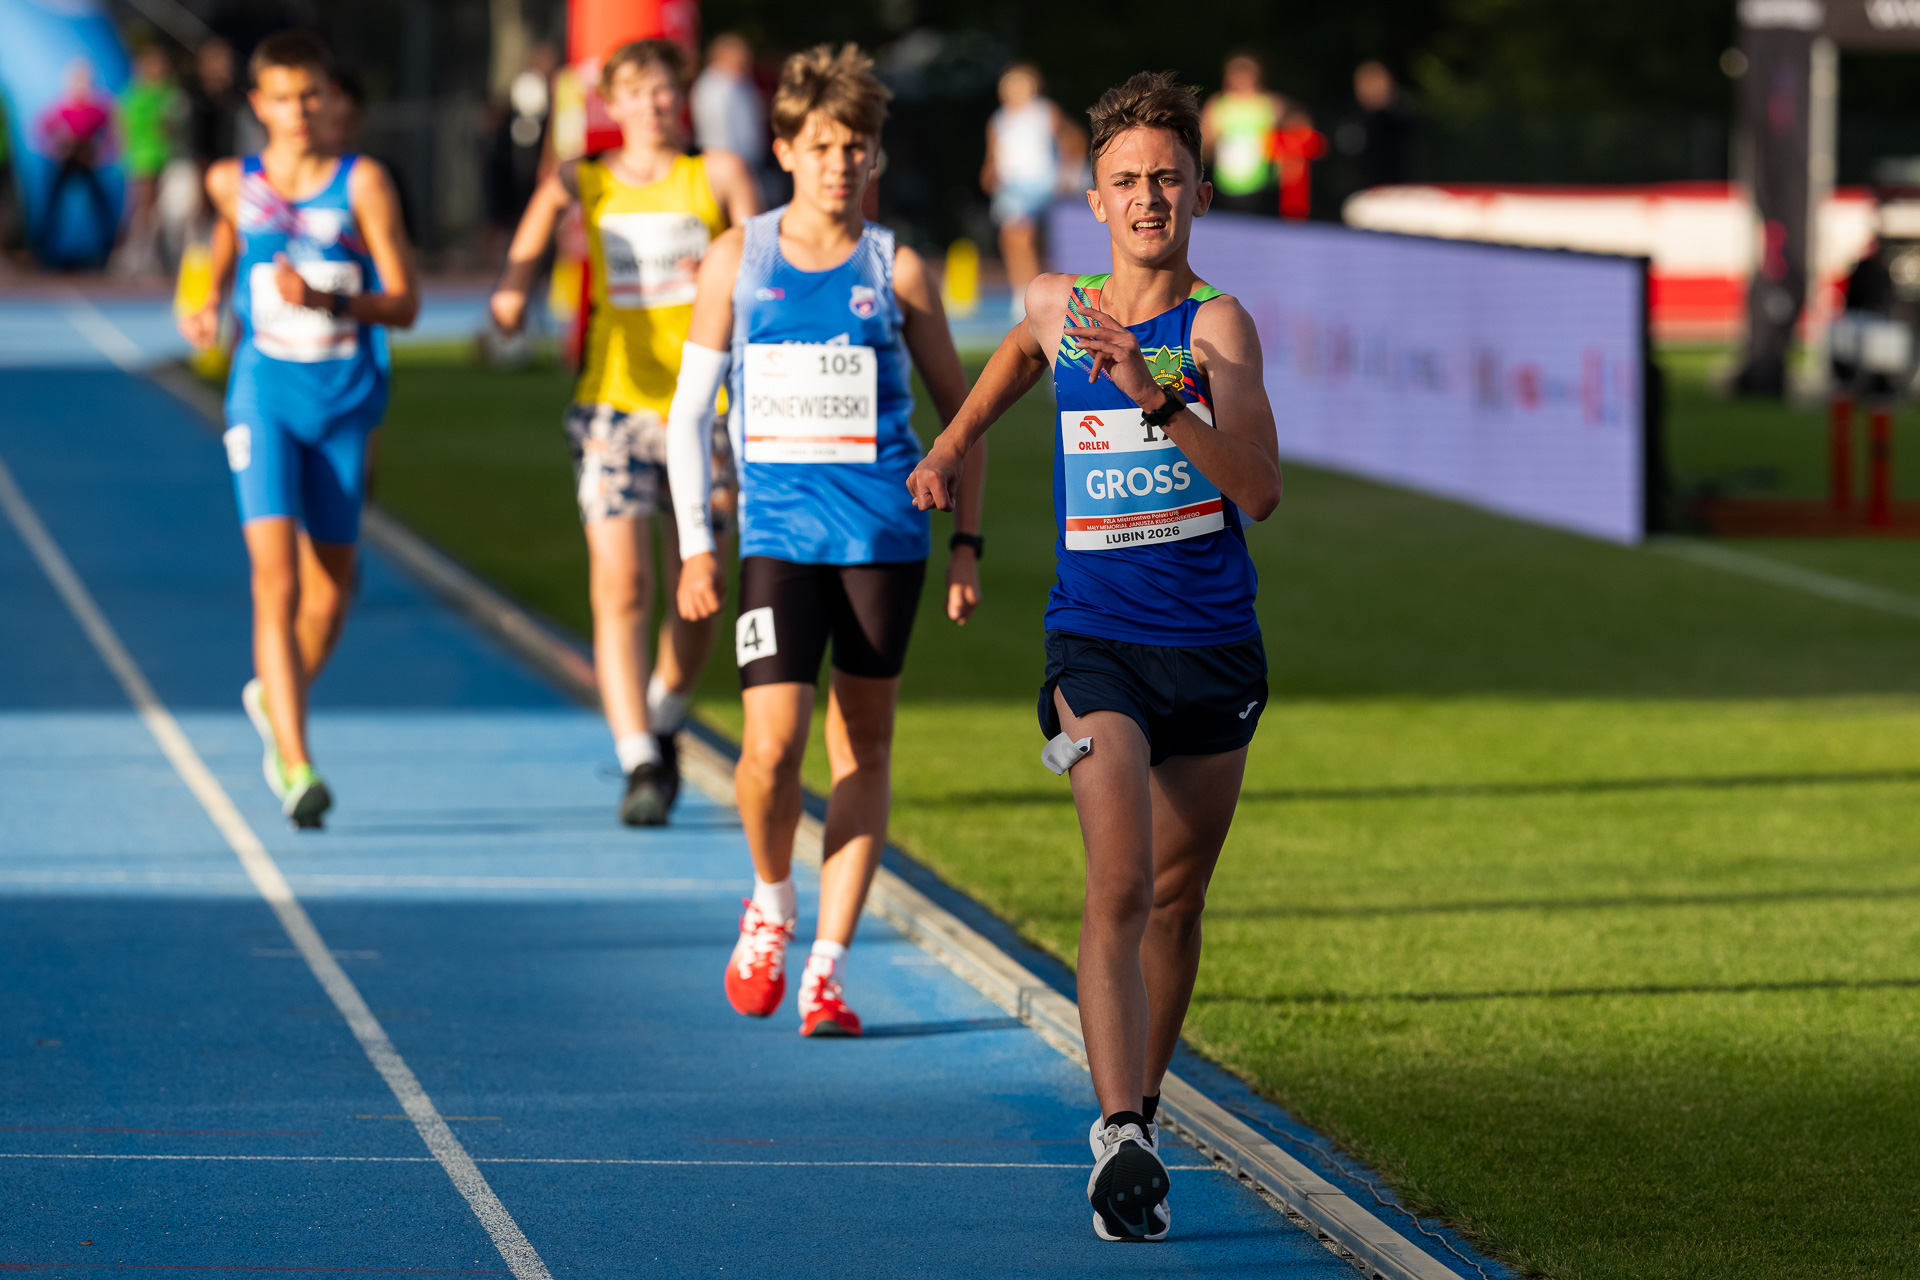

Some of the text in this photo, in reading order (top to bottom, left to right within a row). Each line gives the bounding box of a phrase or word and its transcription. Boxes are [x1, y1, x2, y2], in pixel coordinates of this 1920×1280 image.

[819, 354, 862, 375] 105
[1078, 441, 1110, 451] ORLEN
[1086, 460, 1191, 500] GROSS
[1117, 514, 1151, 523] Mistrzostwa
[1151, 511, 1168, 519] Polski
[1128, 520, 1154, 528] JANUSZA
[1106, 526, 1180, 544] LUBIN 2026
[744, 616, 764, 651] 4
